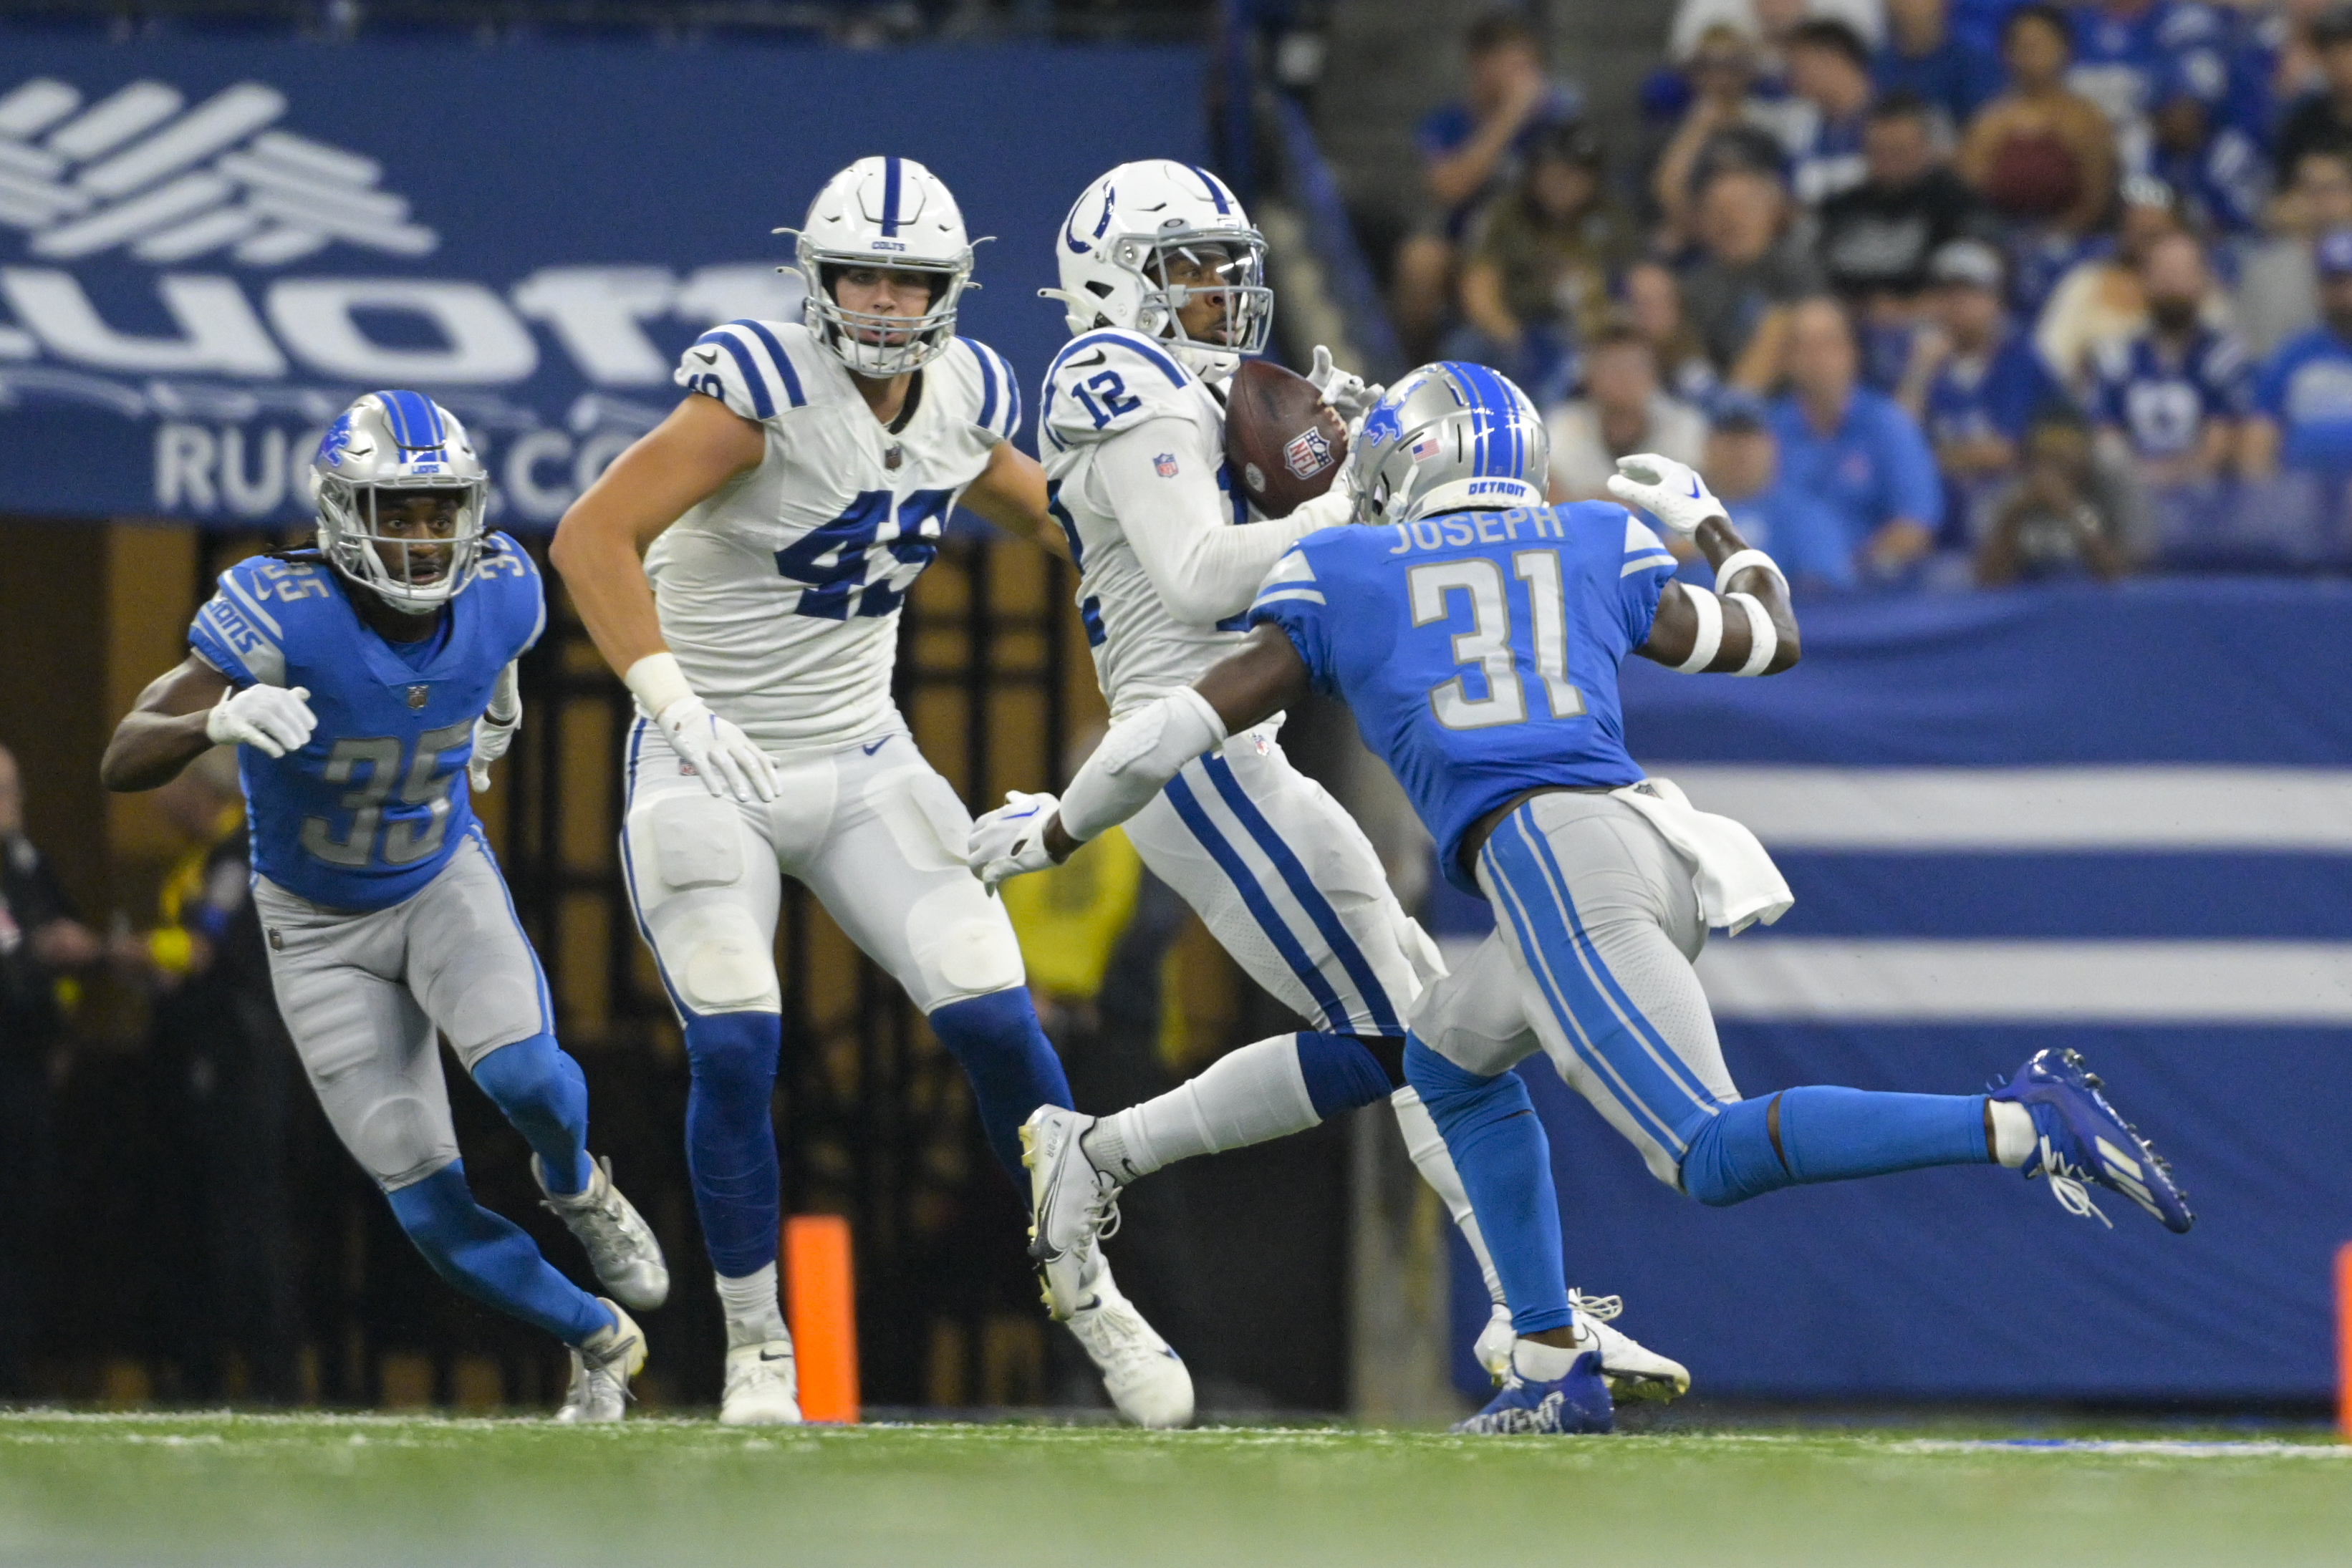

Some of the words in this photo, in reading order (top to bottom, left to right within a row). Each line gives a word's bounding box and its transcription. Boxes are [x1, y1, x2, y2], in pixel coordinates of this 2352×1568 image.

[871, 241, 906, 252] COLTS
[1071, 369, 1142, 431] 12
[411, 464, 440, 474] LIONS
[1288, 440, 1316, 474] NFL
[1468, 481, 1527, 498] DETROIT
[1389, 505, 1565, 554] JOSEPH
[259, 561, 330, 603] 35
[1406, 548, 1588, 730] 31
[300, 716, 471, 866] 35
